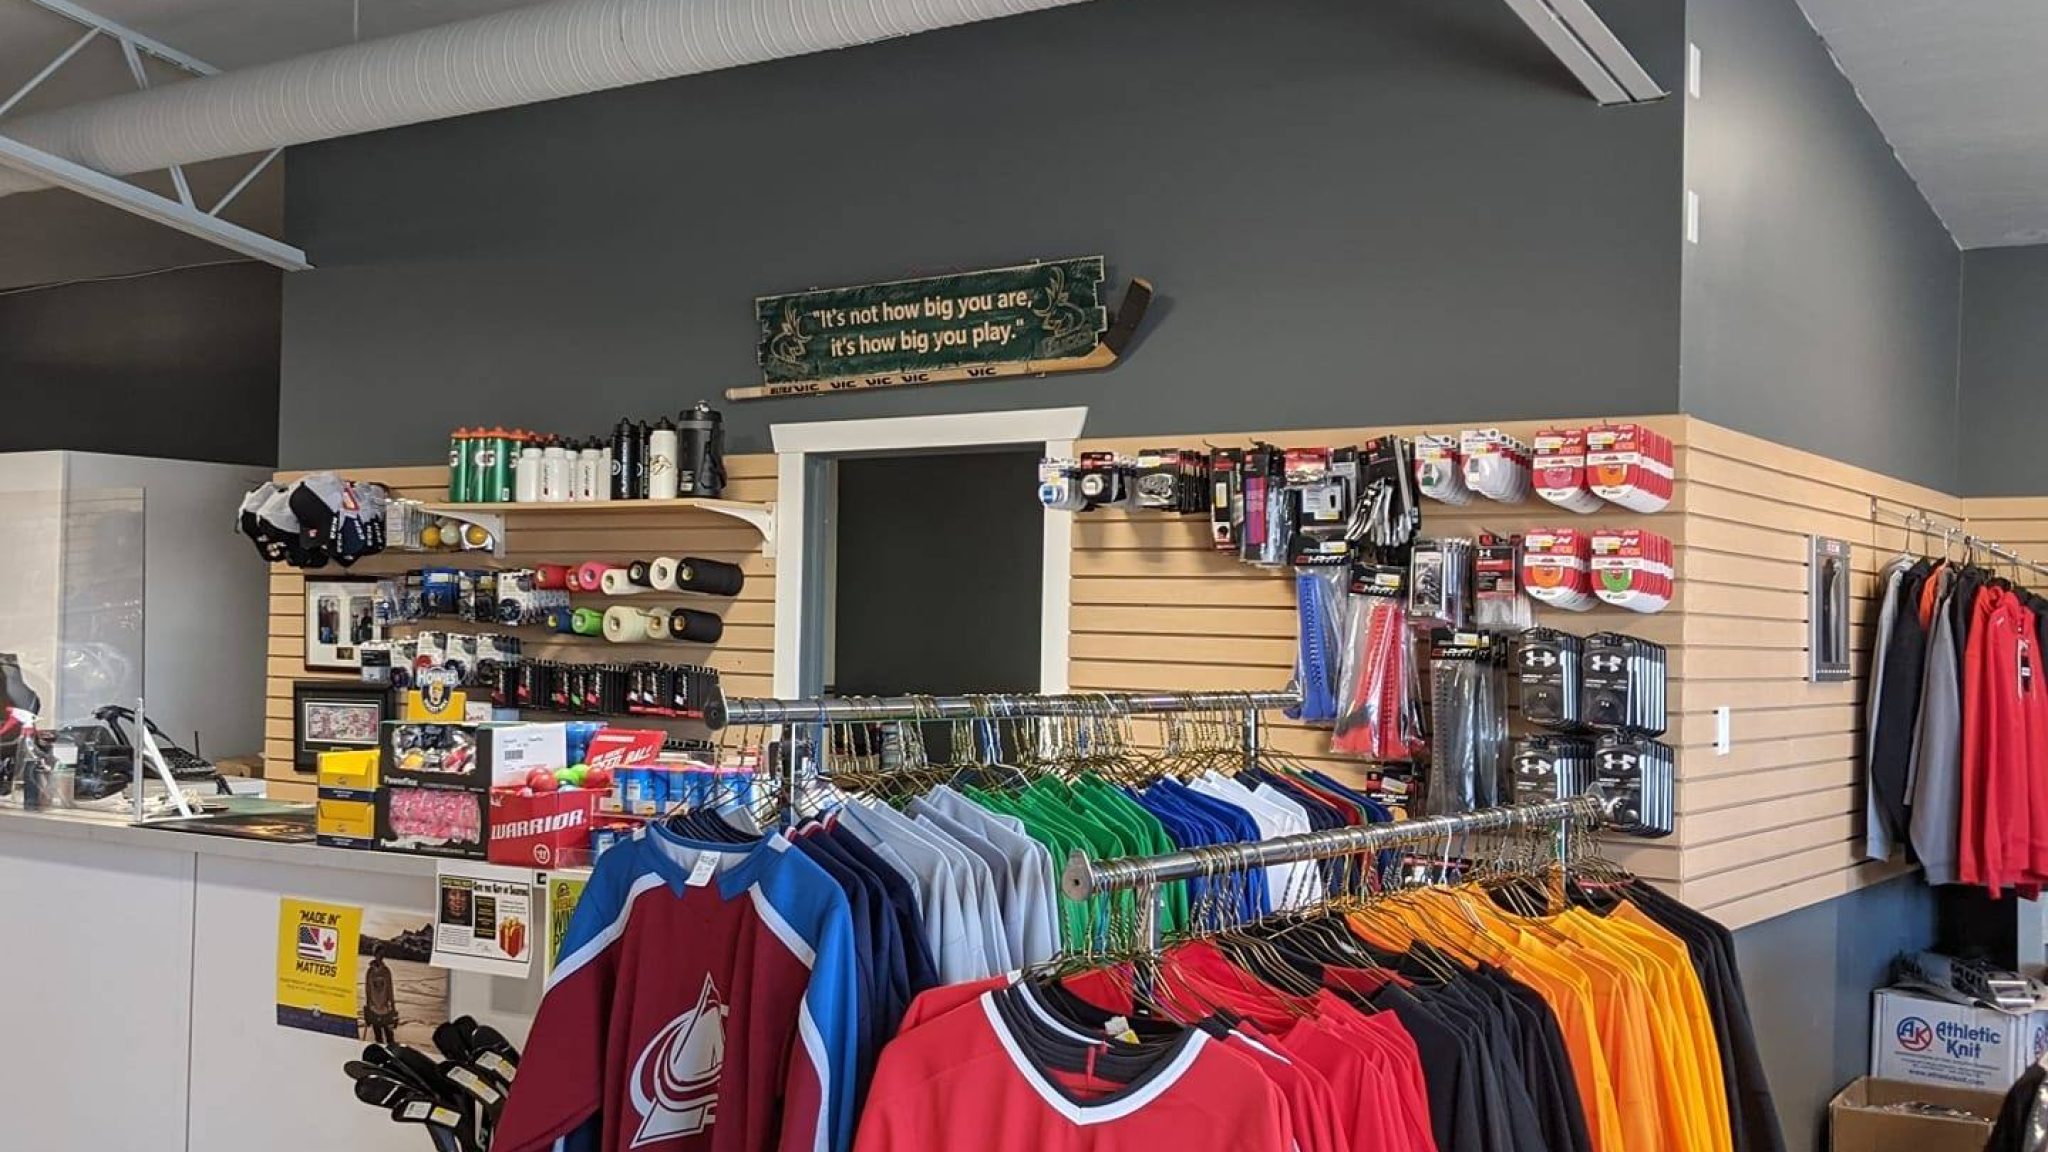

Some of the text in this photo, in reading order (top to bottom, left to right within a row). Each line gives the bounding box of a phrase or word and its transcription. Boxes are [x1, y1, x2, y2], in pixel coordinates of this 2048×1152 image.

[812, 291, 1032, 329] "It's not how big you are,
[831, 336, 856, 358] it's
[859, 334, 896, 354] how
[901, 329, 929, 354] big
[933, 329, 967, 353] you
[972, 317, 1024, 349] play."
[794, 382, 820, 392] VIC
[830, 380, 857, 389] VIC
[865, 376, 893, 386] VIC
[901, 373, 930, 383] VIC
[966, 366, 998, 377] VIC
[491, 808, 585, 840] WARRIOR
[296, 960, 338, 977] MATTERS
[1935, 1020, 2001, 1045] Athletic
[1946, 1038, 1982, 1058] Knit
